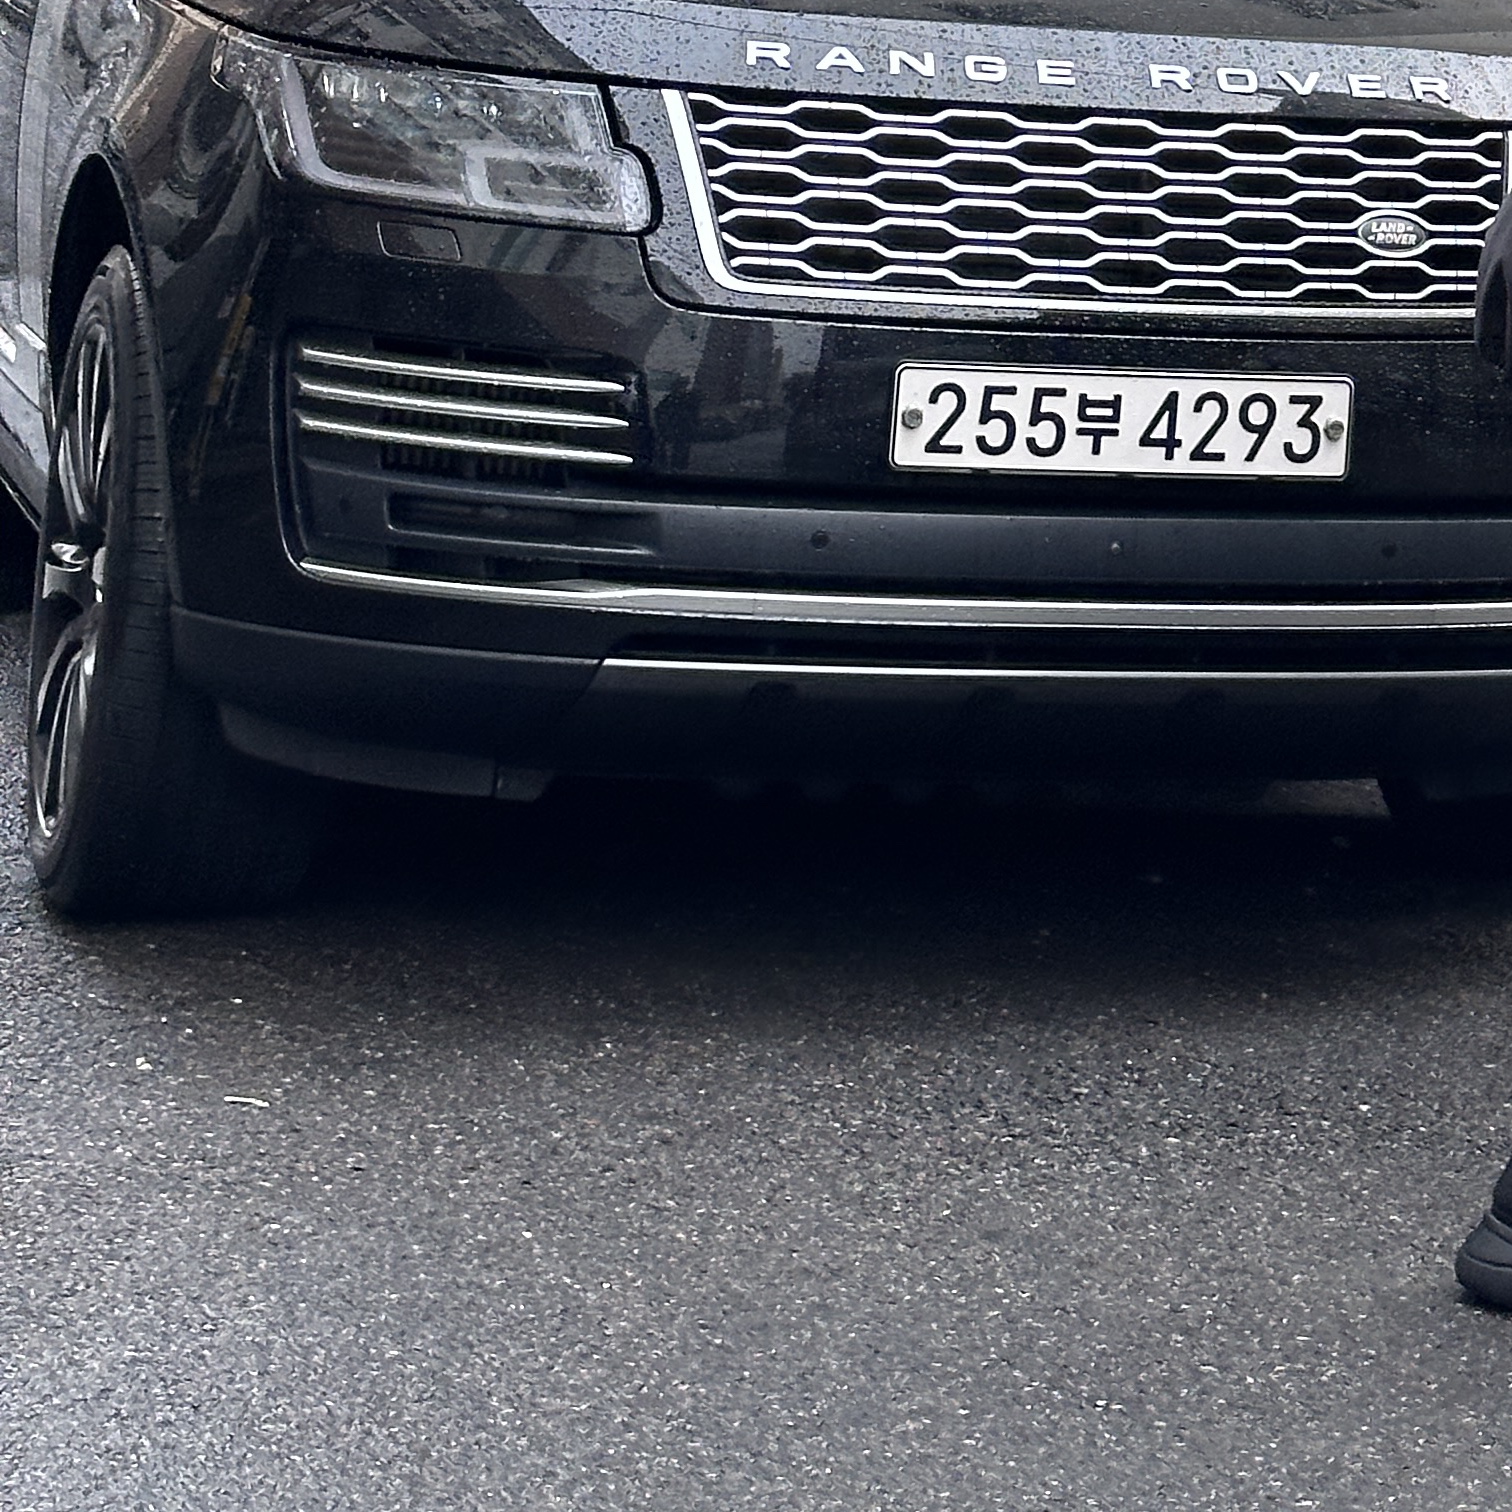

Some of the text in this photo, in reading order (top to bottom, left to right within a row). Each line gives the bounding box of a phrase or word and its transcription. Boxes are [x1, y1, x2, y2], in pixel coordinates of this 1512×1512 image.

[745, 40, 1452, 102] RANGE ROVER
[1371, 221, 1406, 233] LAND
[1375, 232, 1417, 245] ROVER
[923, 382, 1324, 464] 255부 4293
